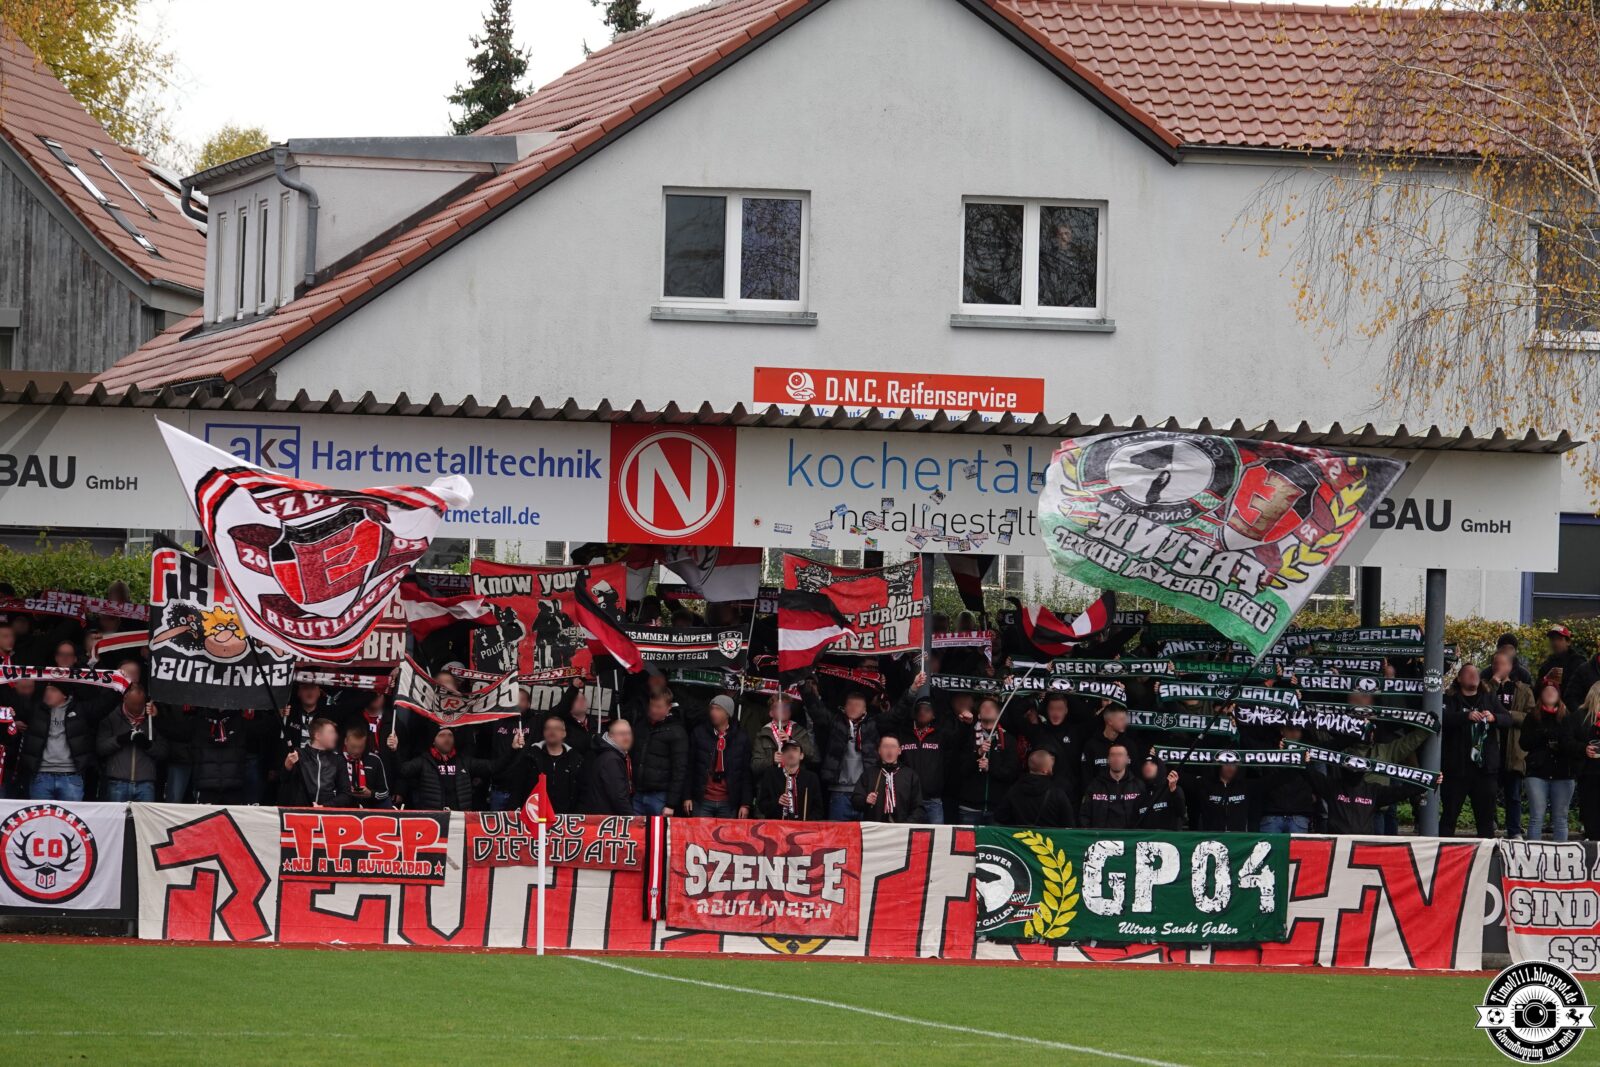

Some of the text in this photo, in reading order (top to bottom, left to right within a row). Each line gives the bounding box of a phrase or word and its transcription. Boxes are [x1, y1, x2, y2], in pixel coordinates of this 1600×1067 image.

[825, 377, 1018, 409] D.N.C. Reifenservice
[311, 438, 602, 481] Hartmetalltechnik
[86, 476, 138, 491] GmbH
[635, 441, 710, 529] N
[443, 505, 541, 526] tmetall.de
[829, 502, 1041, 544] metallgestalt
[1461, 518, 1512, 534] GmbH
[242, 547, 269, 569] 20
[429, 574, 471, 587] SZEN
[473, 572, 588, 597] know you
[24, 599, 80, 614] SZENE
[266, 568, 406, 638] REUTLINGEN
[859, 604, 891, 627] FÜR
[895, 600, 923, 620] DIE
[1114, 613, 1144, 625] WER
[672, 633, 712, 643] KÄMPFEN
[1359, 628, 1422, 641] GALLEN
[480, 641, 506, 660] POLICE
[677, 652, 709, 661] SIEGEN
[151, 656, 294, 687] EUTLINGE
[1053, 662, 1097, 674] REEN
[1322, 660, 1381, 672] POWER
[931, 676, 972, 689] REEN
[1159, 684, 1216, 697] SANKT
[1300, 675, 1352, 690] GREEN
[1126, 711, 1153, 725] NKT
[1245, 752, 1302, 764] POWER
[1287, 743, 1434, 785] GEEN POWER
[597, 815, 633, 838] AI
[283, 814, 441, 862] TPSP
[290, 857, 432, 876] NO A LA AUTORIDAD
[1501, 841, 1587, 882] WIR
[685, 842, 848, 905] SZENE E
[1082, 840, 1275, 916] GP04
[696, 898, 832, 919] REUTLINGEN
[982, 905, 1015, 927] GALLEN
[1509, 888, 1599, 928] SIND
[1118, 921, 1239, 936] Ultras Sankt Gallen
